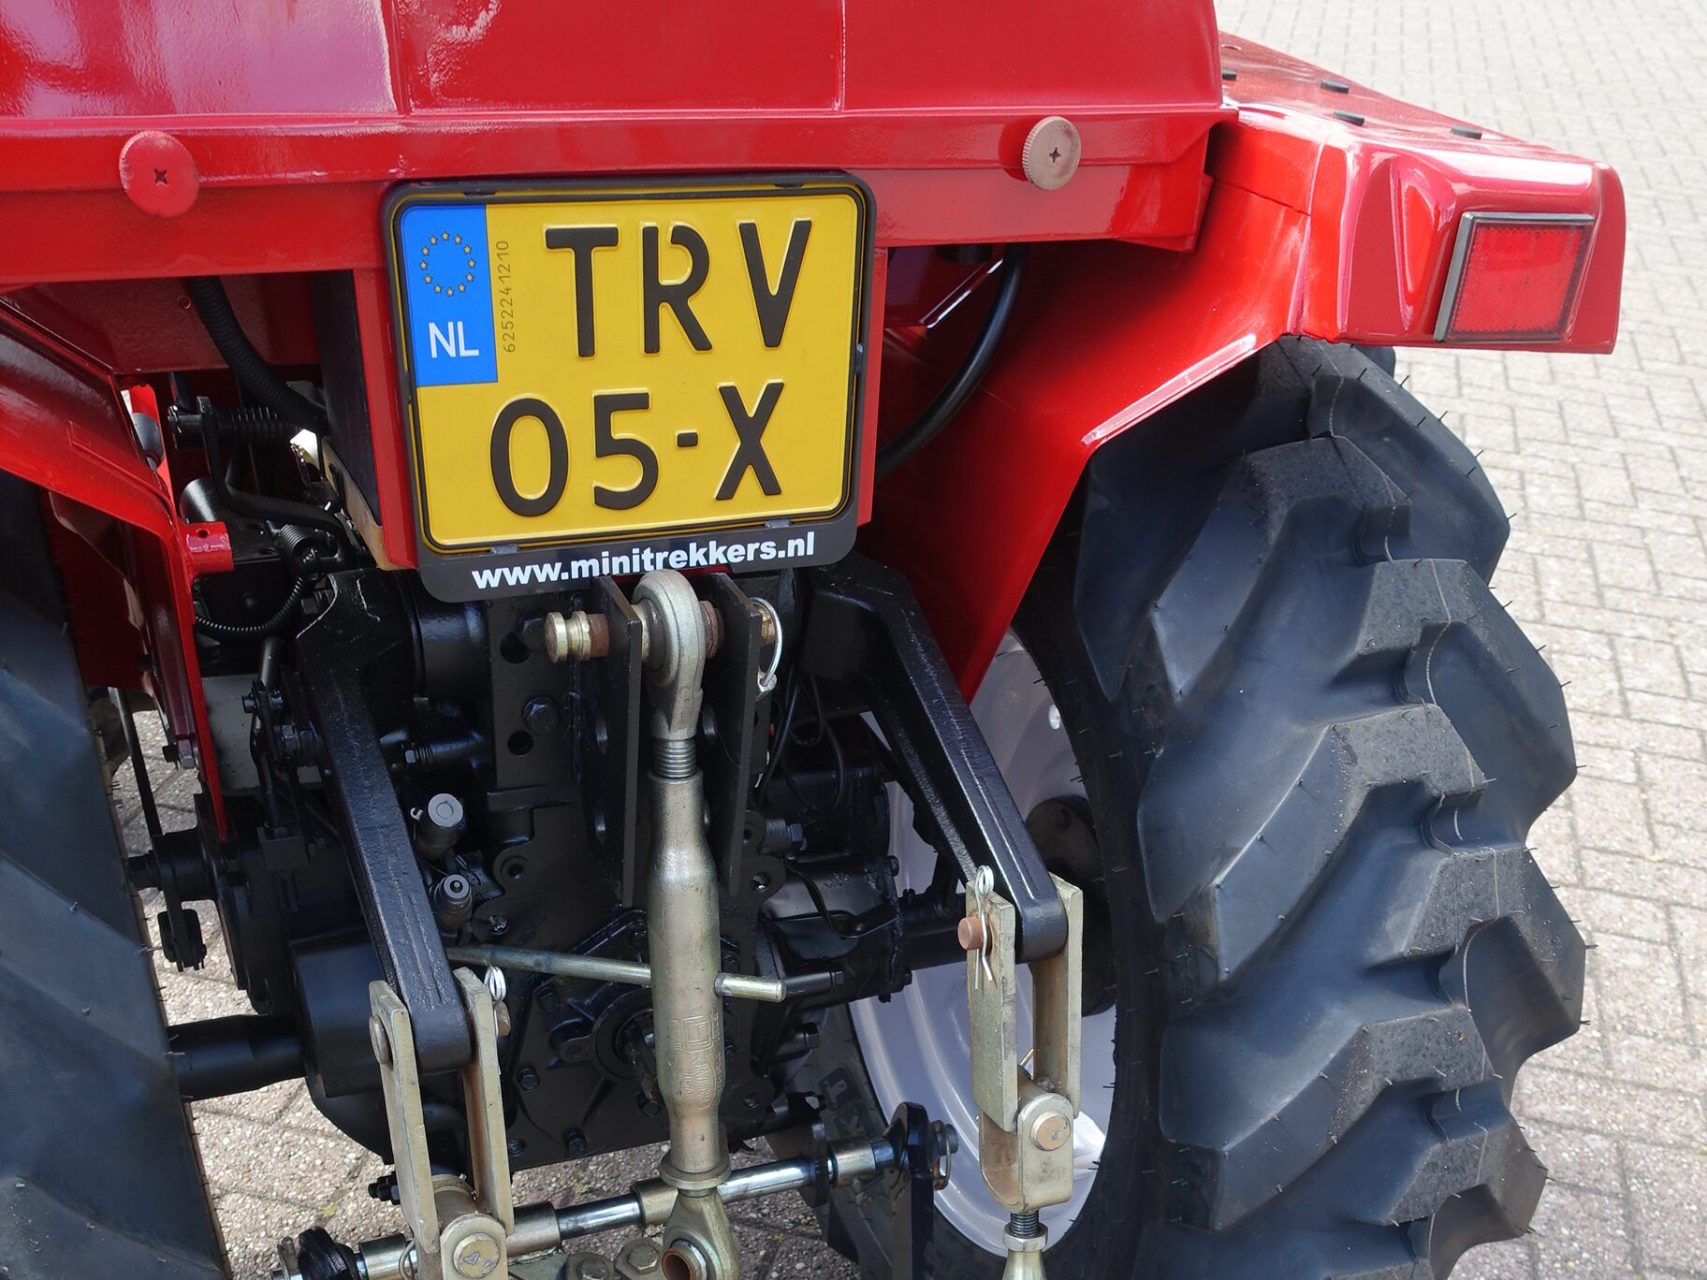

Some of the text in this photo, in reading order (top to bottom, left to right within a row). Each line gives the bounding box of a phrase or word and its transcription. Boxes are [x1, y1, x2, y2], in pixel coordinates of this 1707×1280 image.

[496, 240, 516, 353] 6252241210
[545, 219, 813, 358] TRV
[428, 321, 480, 359] NL
[471, 531, 815, 590] www.minitrekkers.nl
